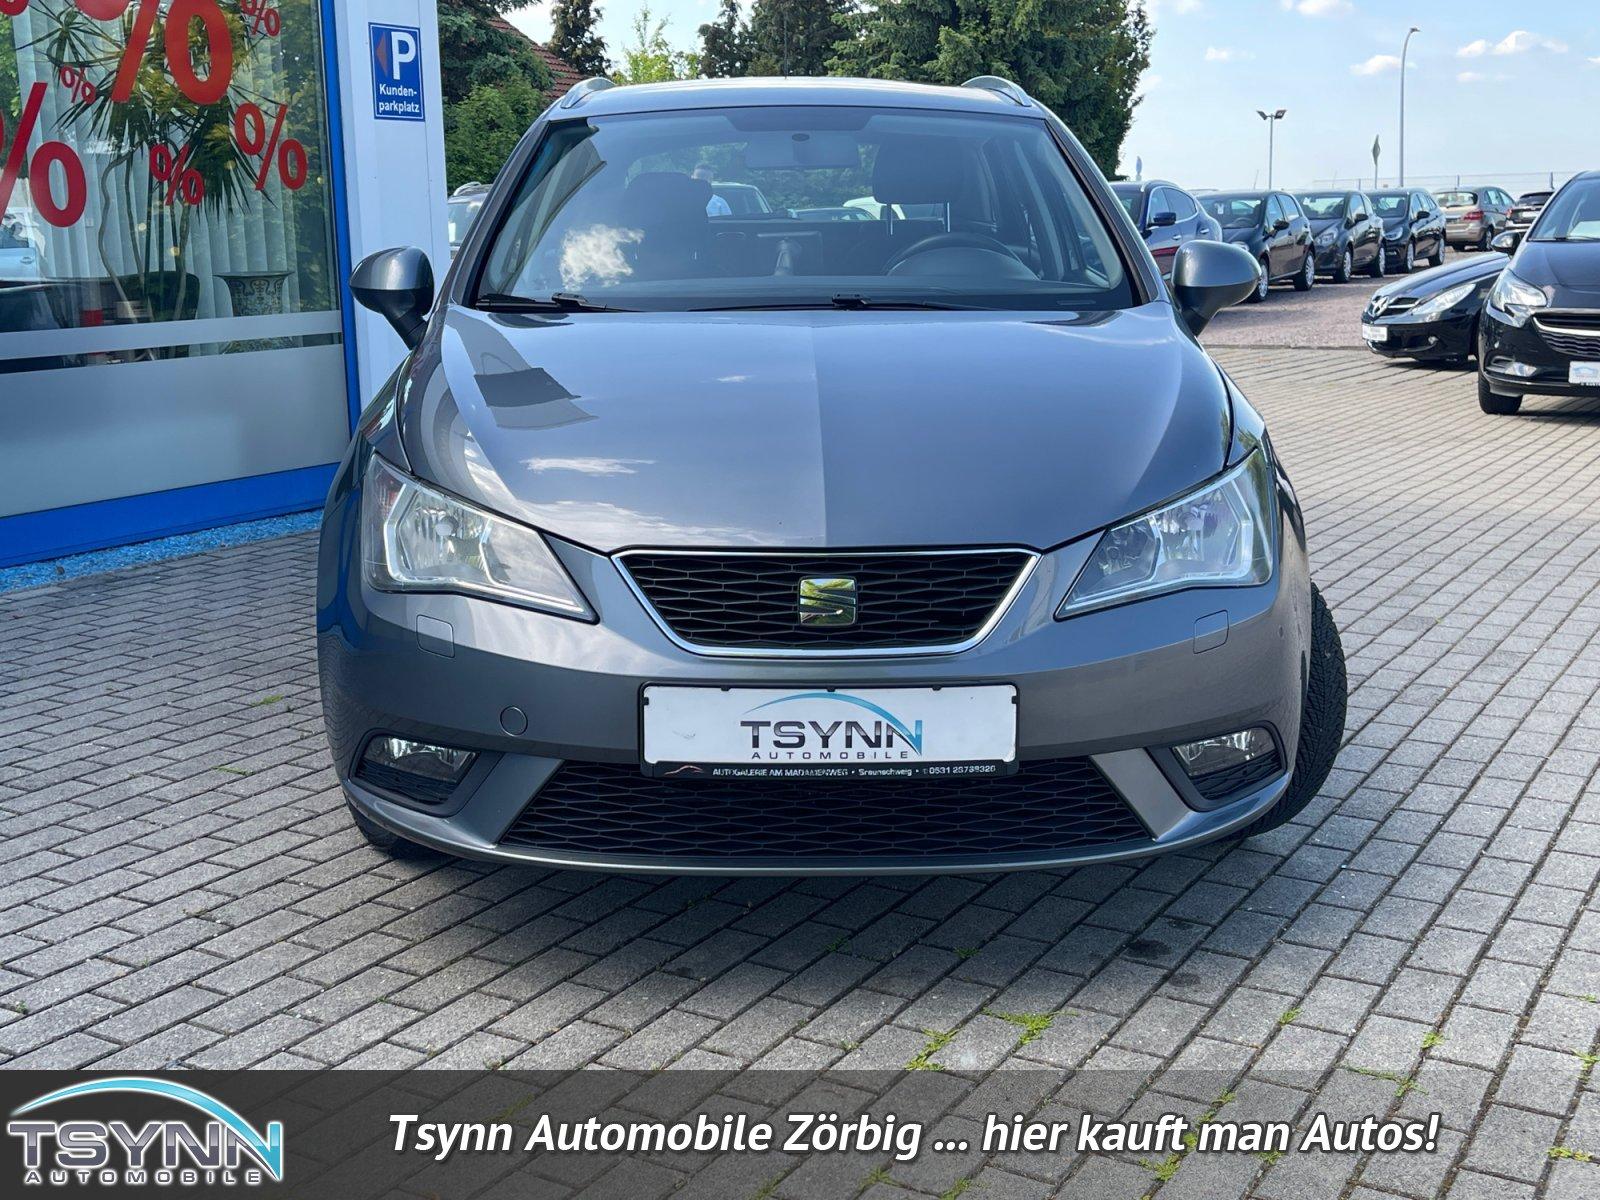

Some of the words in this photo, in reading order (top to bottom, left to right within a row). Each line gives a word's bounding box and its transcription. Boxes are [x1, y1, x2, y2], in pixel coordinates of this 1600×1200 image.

[391, 31, 416, 80] P
[379, 83, 418, 97] Kunden-
[378, 101, 420, 114] parkplatz
[234, 102, 307, 191] %
[150, 144, 204, 205] %
[740, 719, 922, 756] TSYNN
[751, 750, 909, 760] AUTOMOBILE
[769, 768, 783, 777] AM
